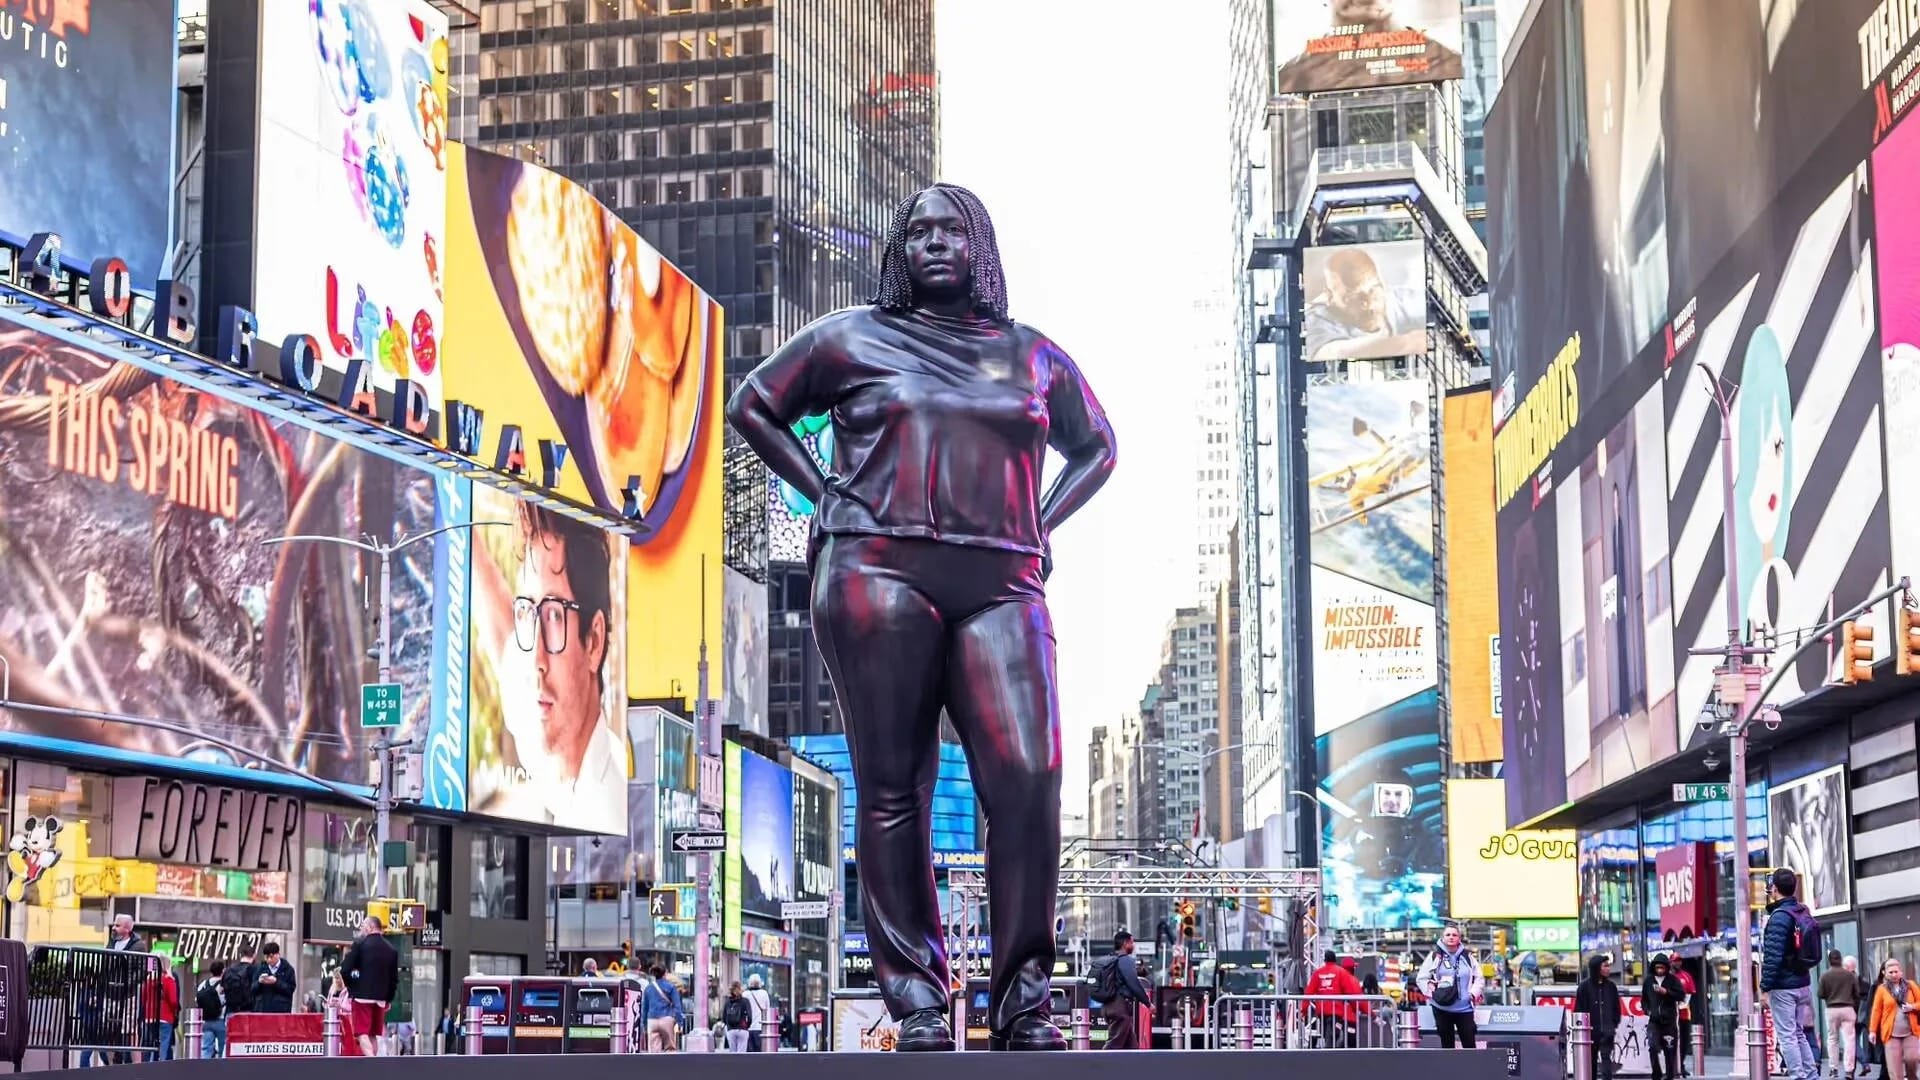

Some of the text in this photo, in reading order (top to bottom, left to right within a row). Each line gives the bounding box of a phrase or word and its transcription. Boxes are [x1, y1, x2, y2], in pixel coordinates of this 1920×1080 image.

[46, 376, 240, 520] THIS SPRING
[1324, 604, 1398, 627] MISSION:
[1324, 626, 1424, 650] IMPOSSIBLE
[376, 688, 388, 698] TO
[367, 701, 375, 710] W
[375, 700, 387, 709] 45
[1687, 786, 1698, 800] W
[1703, 785, 1717, 799] 46
[136, 777, 300, 872] FOREVER
[680, 838, 697, 846] ONE
[326, 907, 345, 926] U.S.
[1523, 927, 1571, 942] KPOP
[176, 928, 243, 961] FOREVER
[244, 1044, 279, 1054] TIMES
